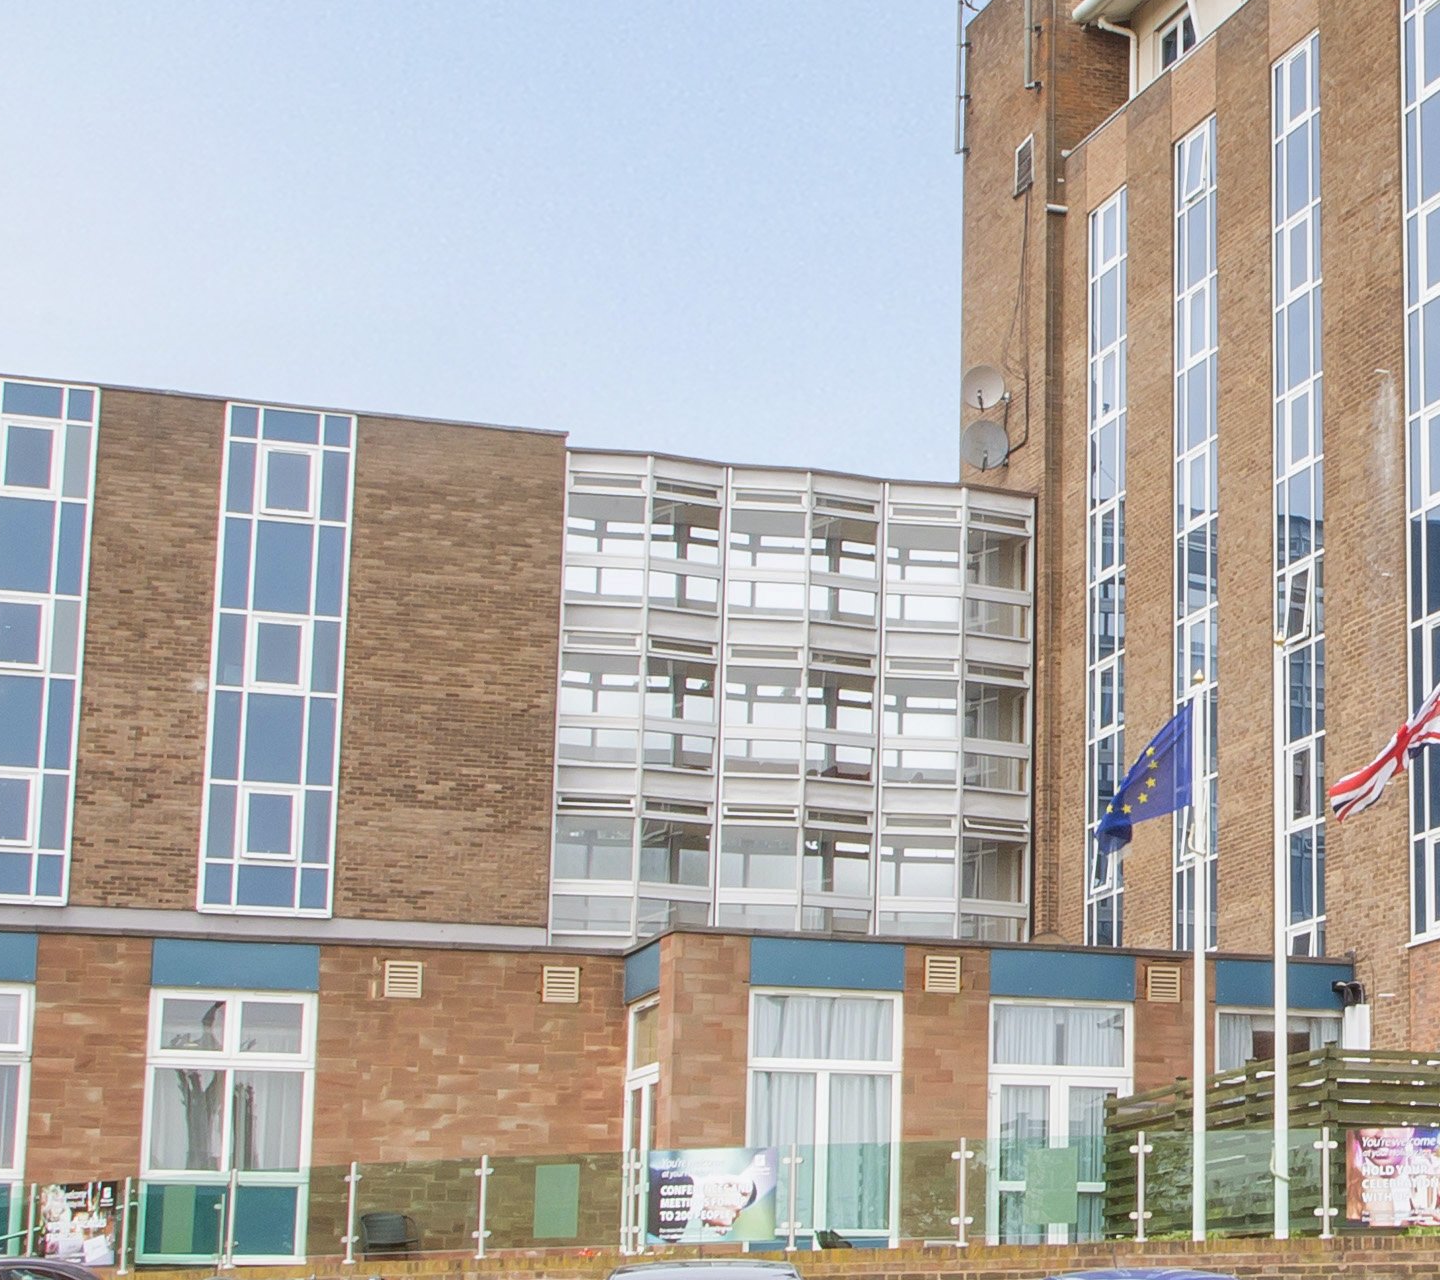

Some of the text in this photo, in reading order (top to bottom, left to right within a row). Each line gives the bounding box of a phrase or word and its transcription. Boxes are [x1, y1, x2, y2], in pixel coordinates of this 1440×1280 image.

[1361, 1165, 1395, 1176] HOLD
[1361, 1192, 1392, 1203] WITH
[659, 1211, 674, 1222] TO
